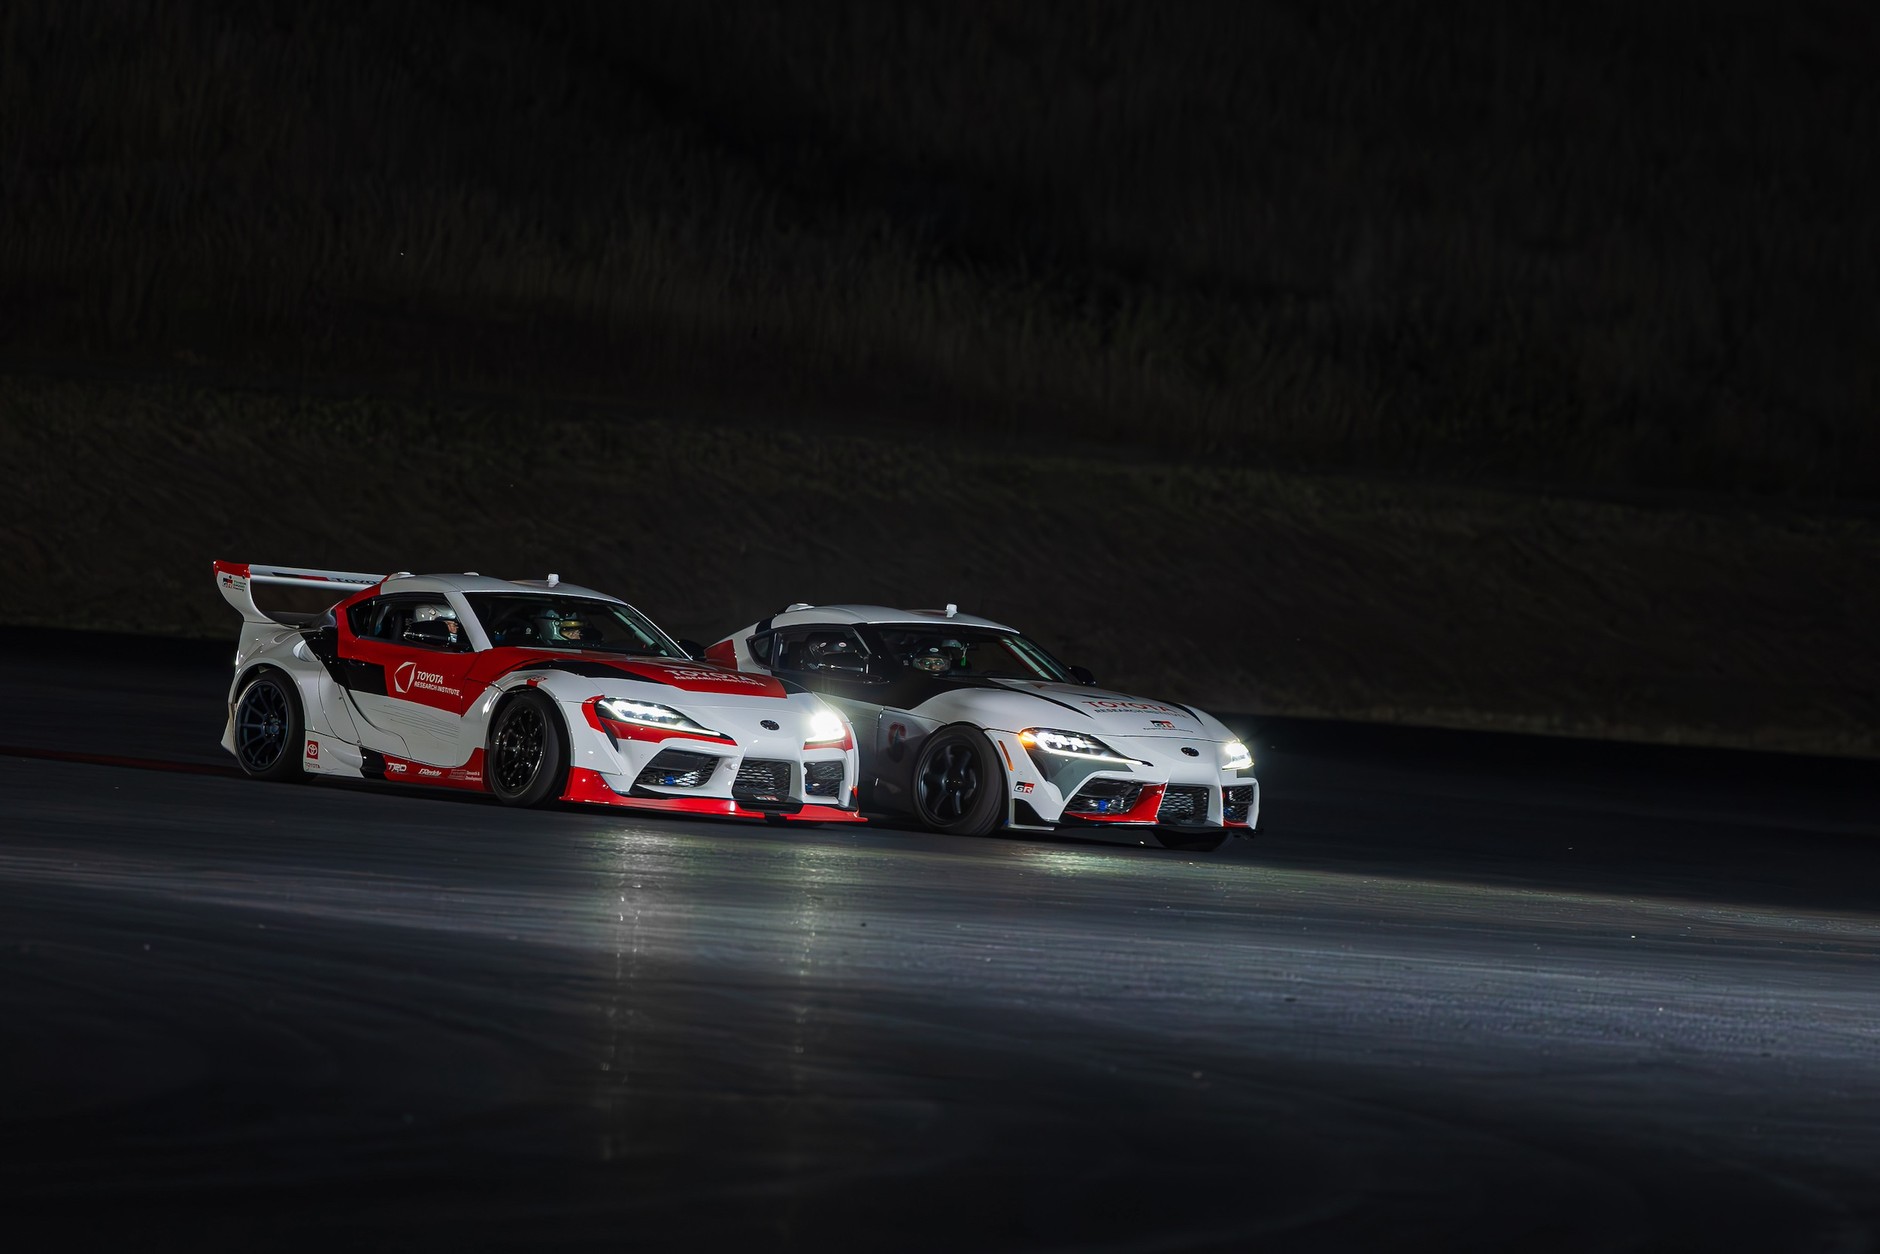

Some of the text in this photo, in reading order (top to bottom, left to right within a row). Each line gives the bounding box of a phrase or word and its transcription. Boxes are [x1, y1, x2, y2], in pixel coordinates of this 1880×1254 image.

[417, 670, 444, 685] TOYOTA
[664, 669, 757, 682] TOYOTA
[414, 681, 460, 696] RESEARCH INSTITUTE
[1081, 701, 1178, 714] TOYOTA
[304, 761, 321, 769] TOYOTA
[387, 762, 407, 773] TRD
[1014, 782, 1034, 795] GR
